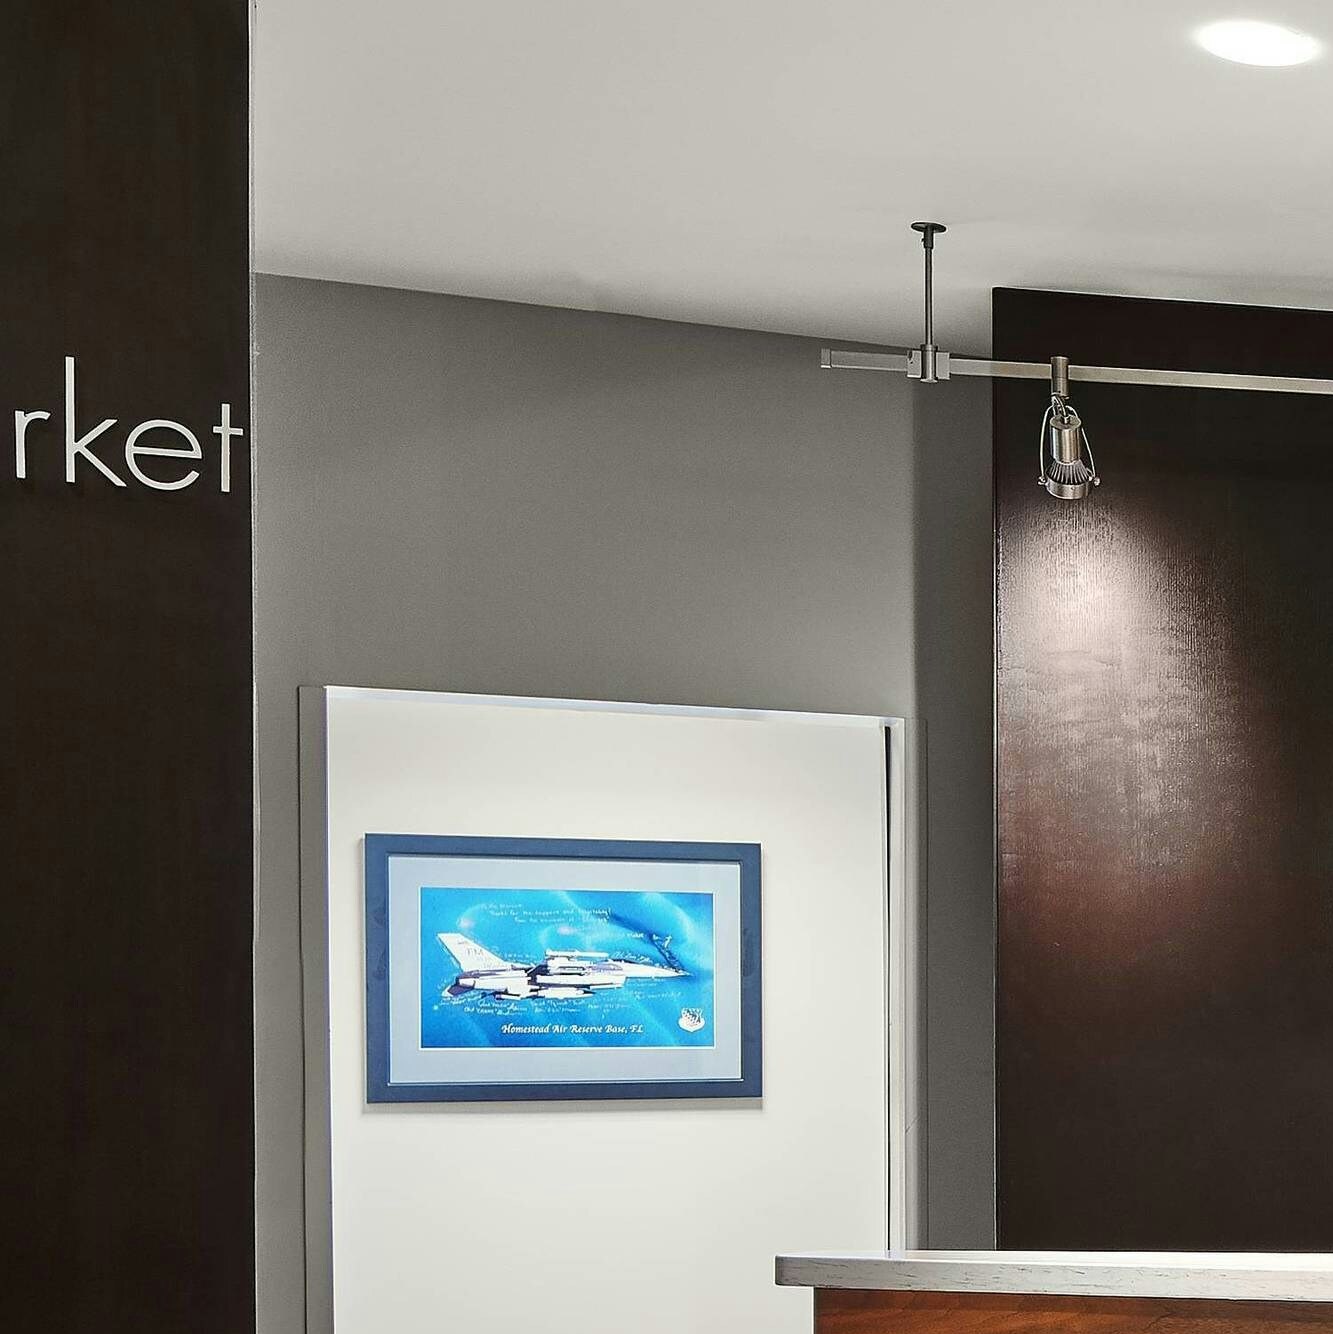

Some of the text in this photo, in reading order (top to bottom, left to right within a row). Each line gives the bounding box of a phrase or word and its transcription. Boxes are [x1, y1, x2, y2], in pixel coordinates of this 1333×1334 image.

[15, 356, 244, 493] rket
[501, 1023, 644, 1035] Homestead Air Reserve Base, FL
